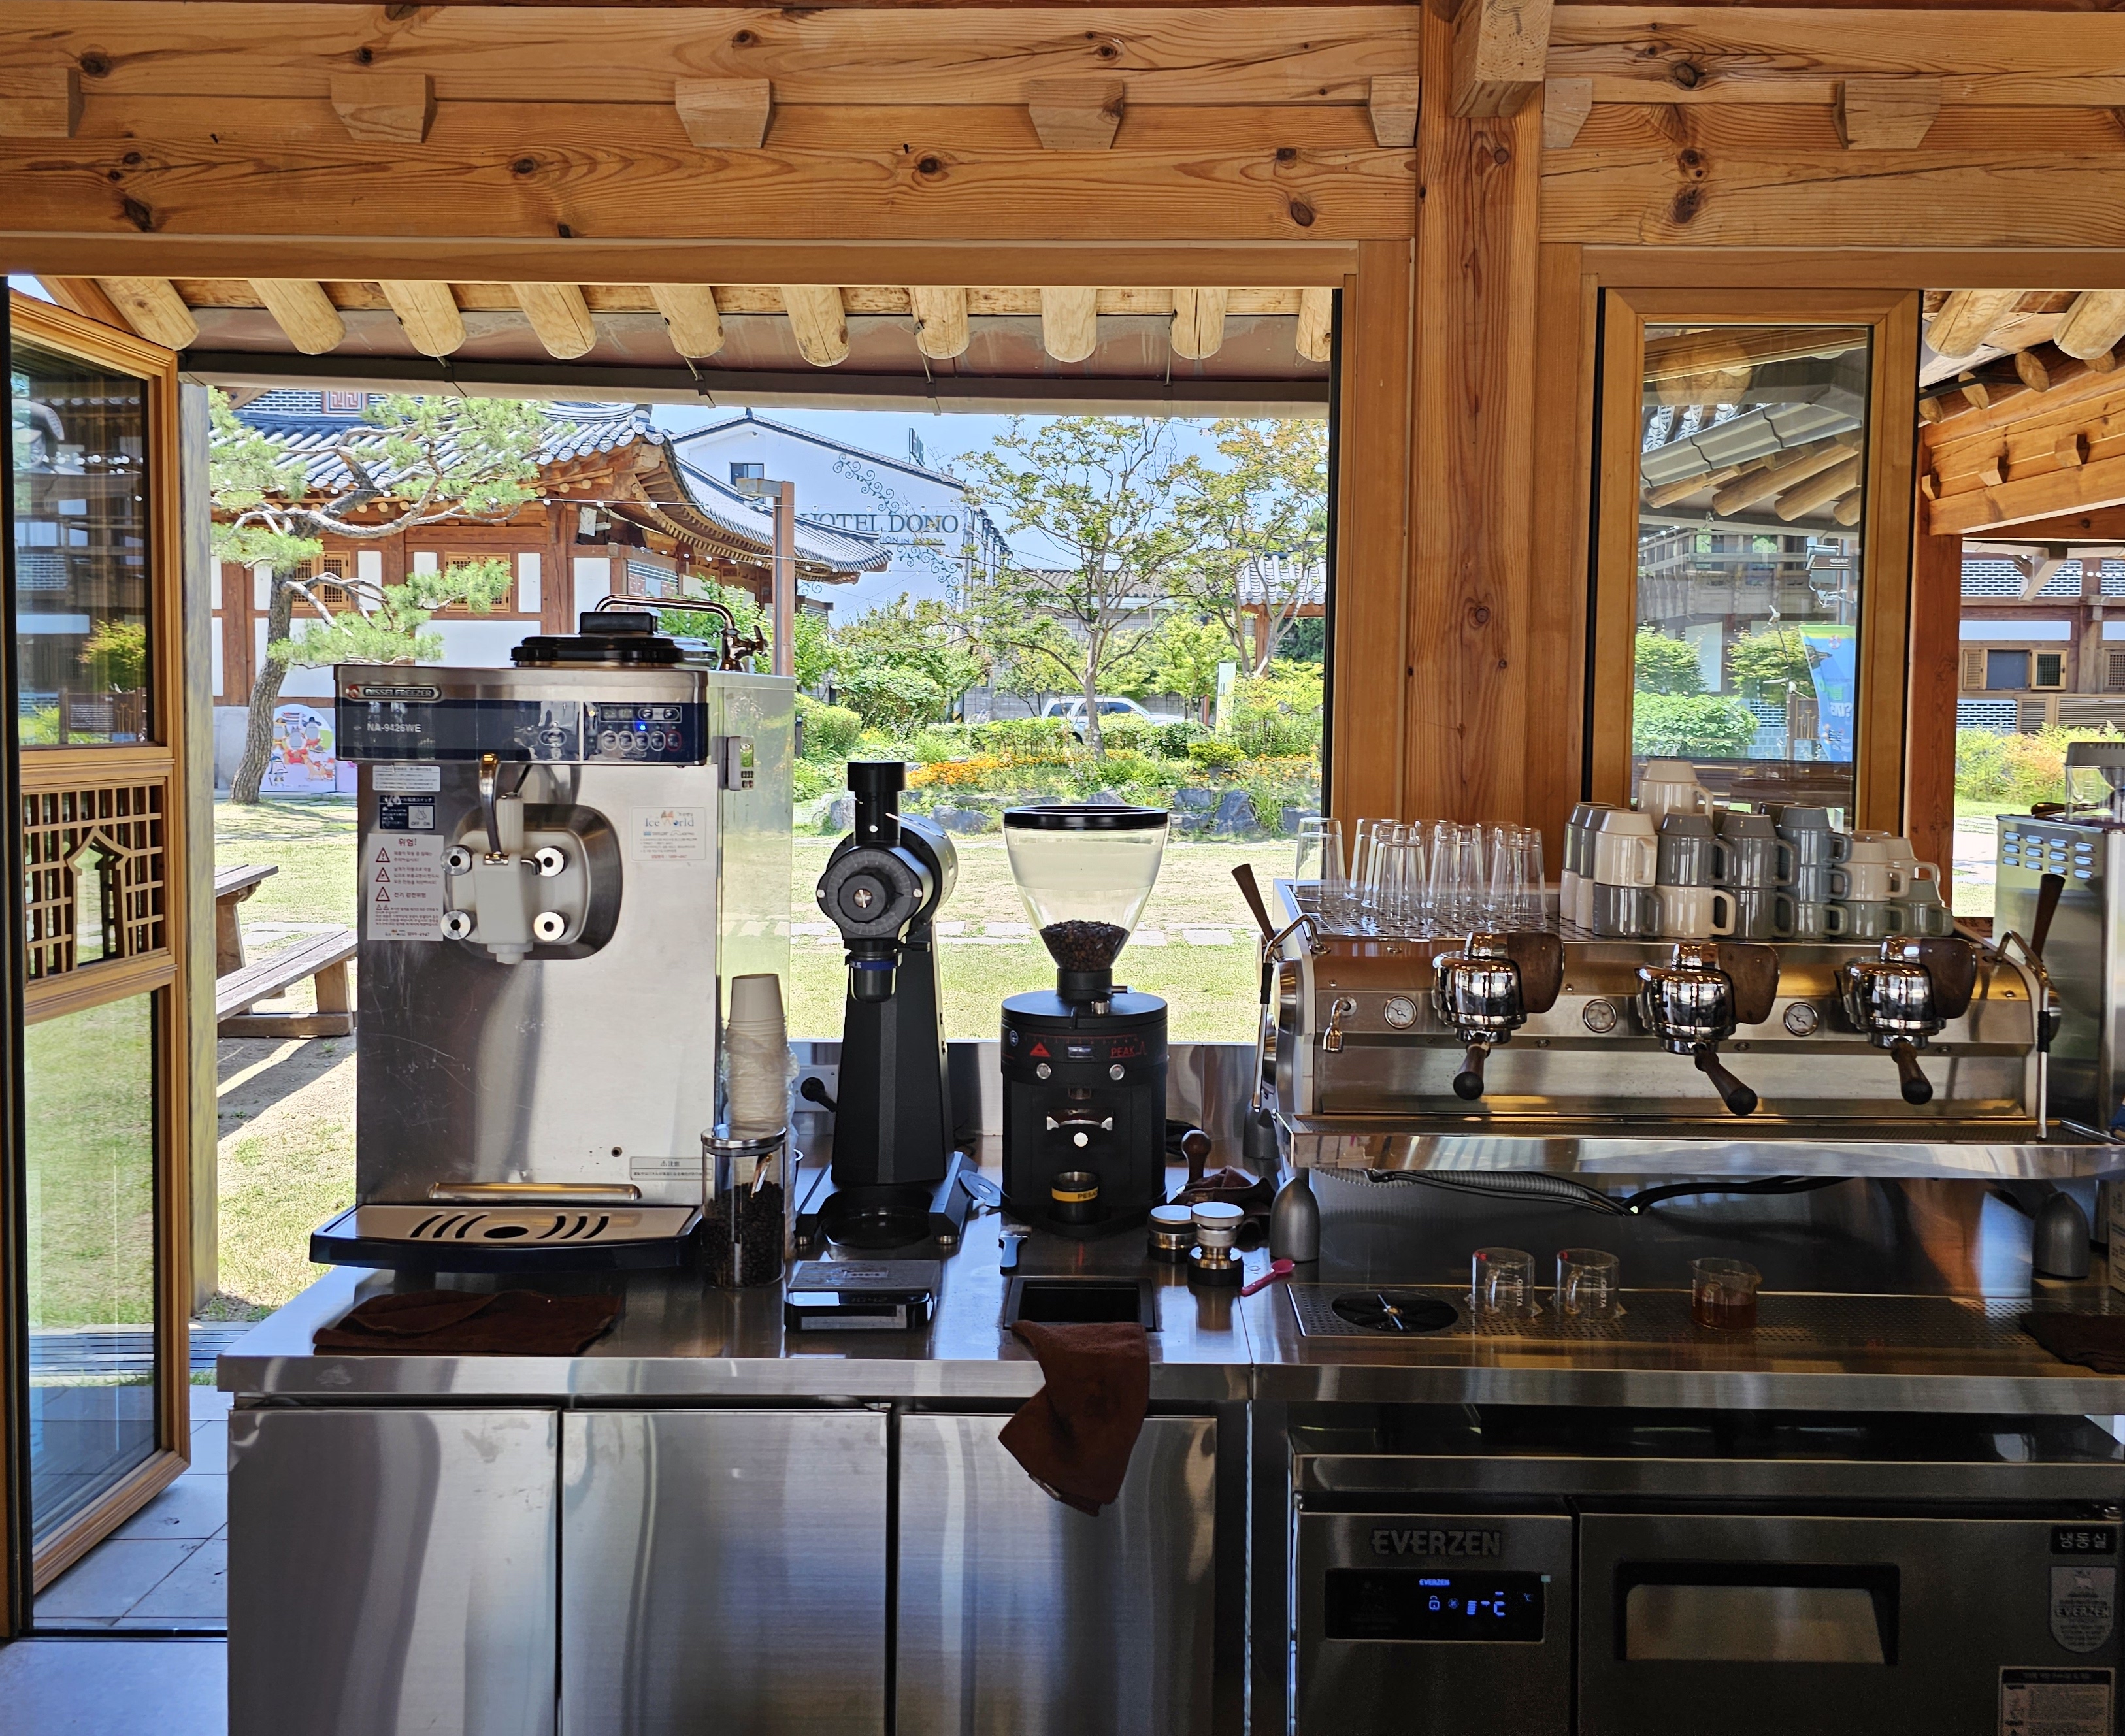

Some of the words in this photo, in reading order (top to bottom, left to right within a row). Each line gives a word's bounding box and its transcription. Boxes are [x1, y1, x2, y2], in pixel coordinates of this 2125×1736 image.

[889, 514, 959, 533] DONO
[367, 723, 421, 732] NA-9426WE
[645, 817, 660, 827] Ice
[398, 838, 417, 847] 위험!
[1111, 1047, 1135, 1057] PEAK
[1372, 1529, 1502, 1556] EVERZEN
[2059, 1532, 2107, 1549] 냉동실
